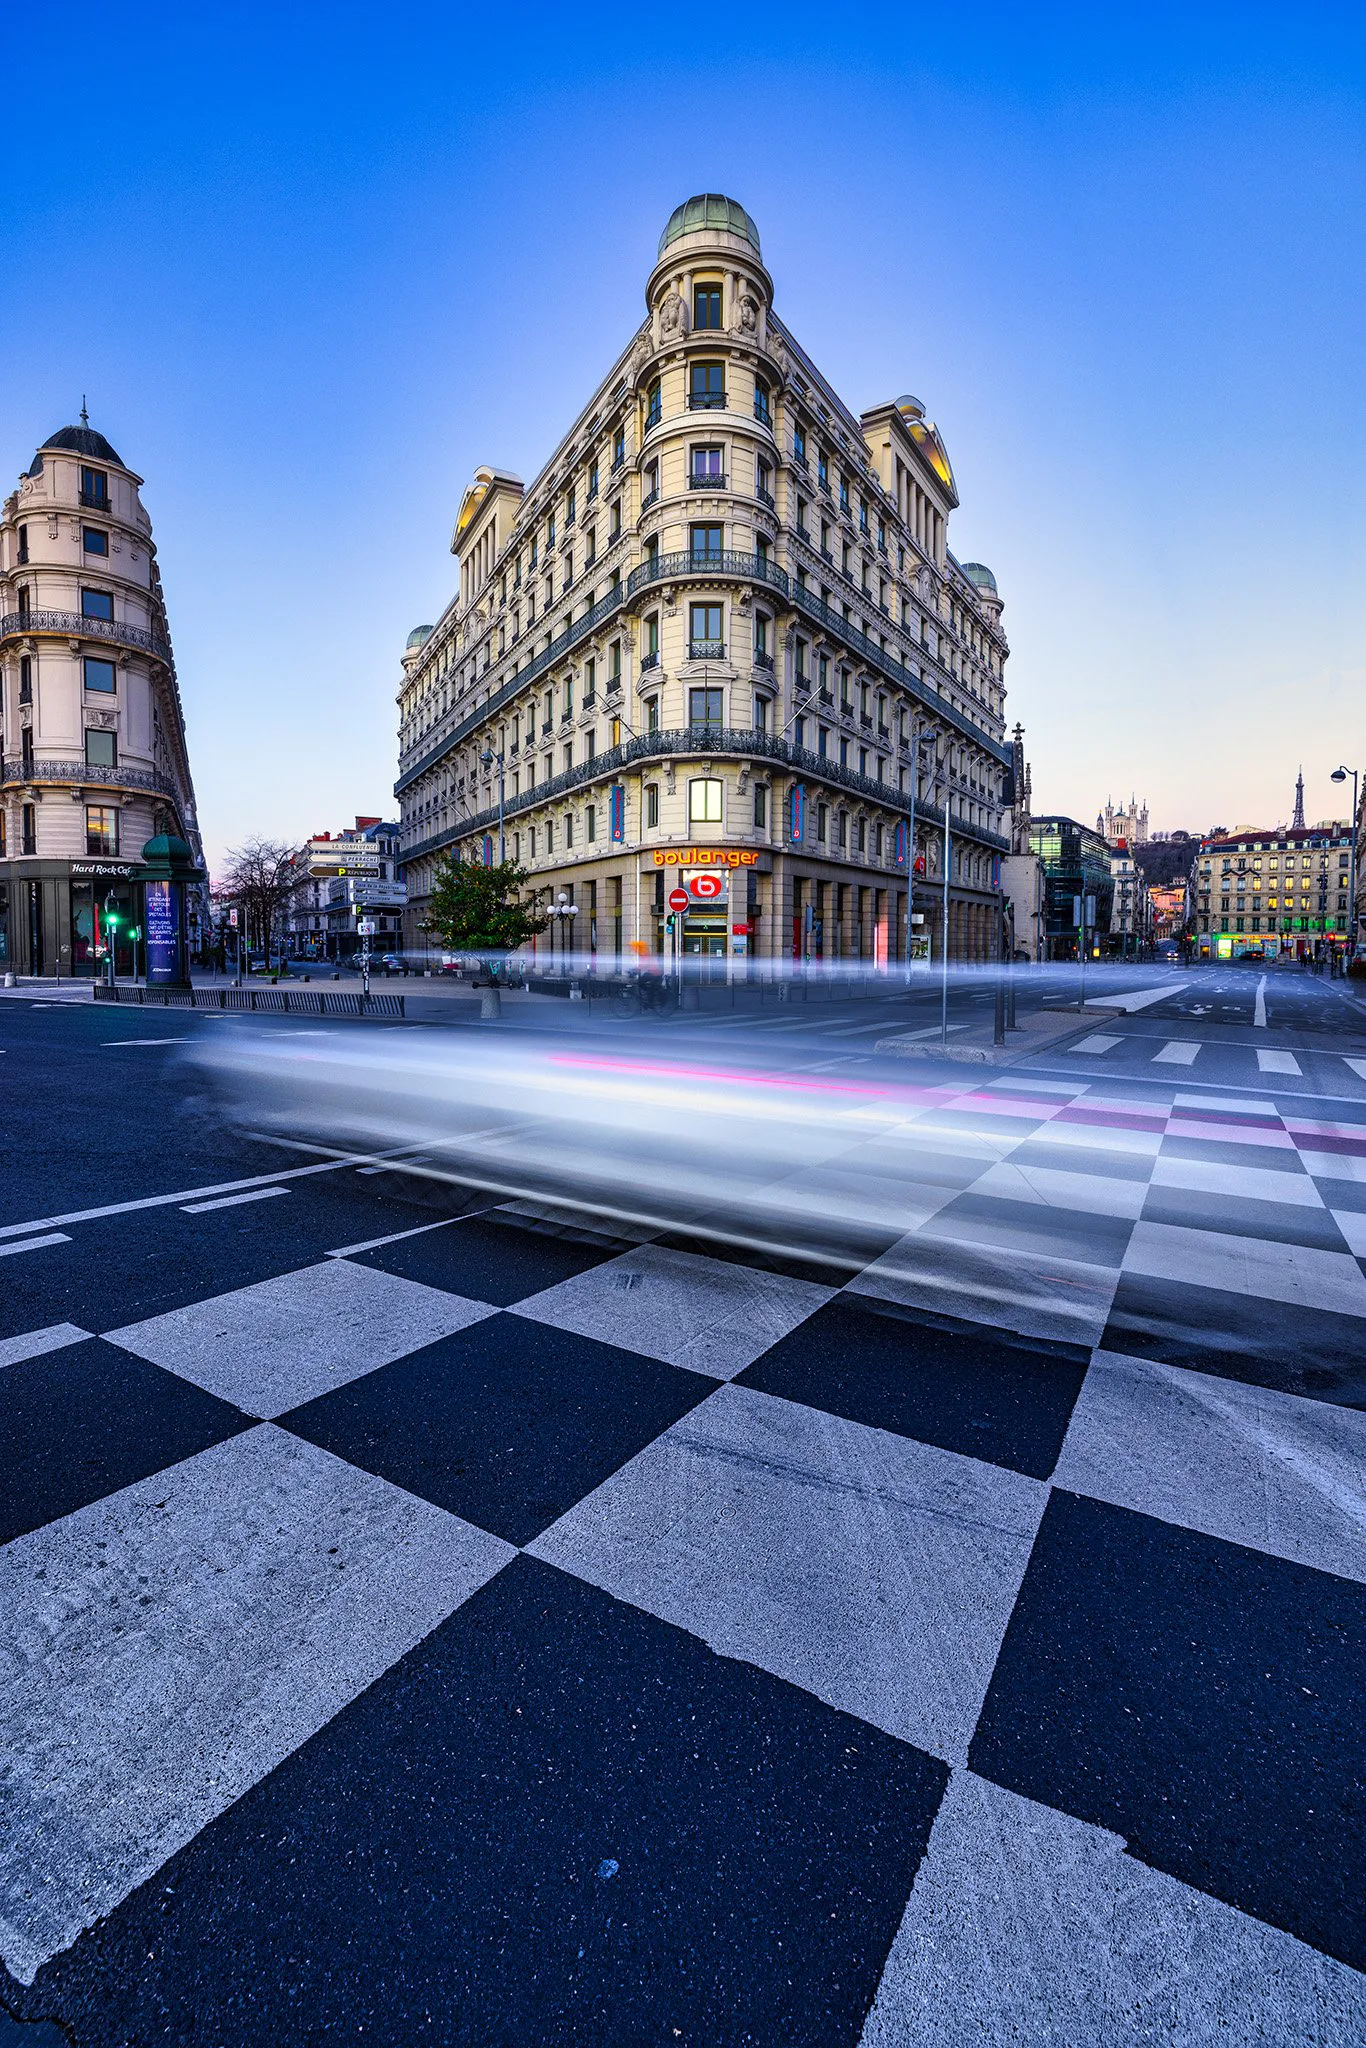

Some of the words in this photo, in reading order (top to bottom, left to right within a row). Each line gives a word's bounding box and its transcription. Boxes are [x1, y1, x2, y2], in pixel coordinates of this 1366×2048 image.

[653, 847, 760, 868] boulanger
[72, 864, 95, 873] Hard
[96, 865, 117, 875] Rock
[117, 866, 132, 876] Caf
[338, 868, 346, 876] P
